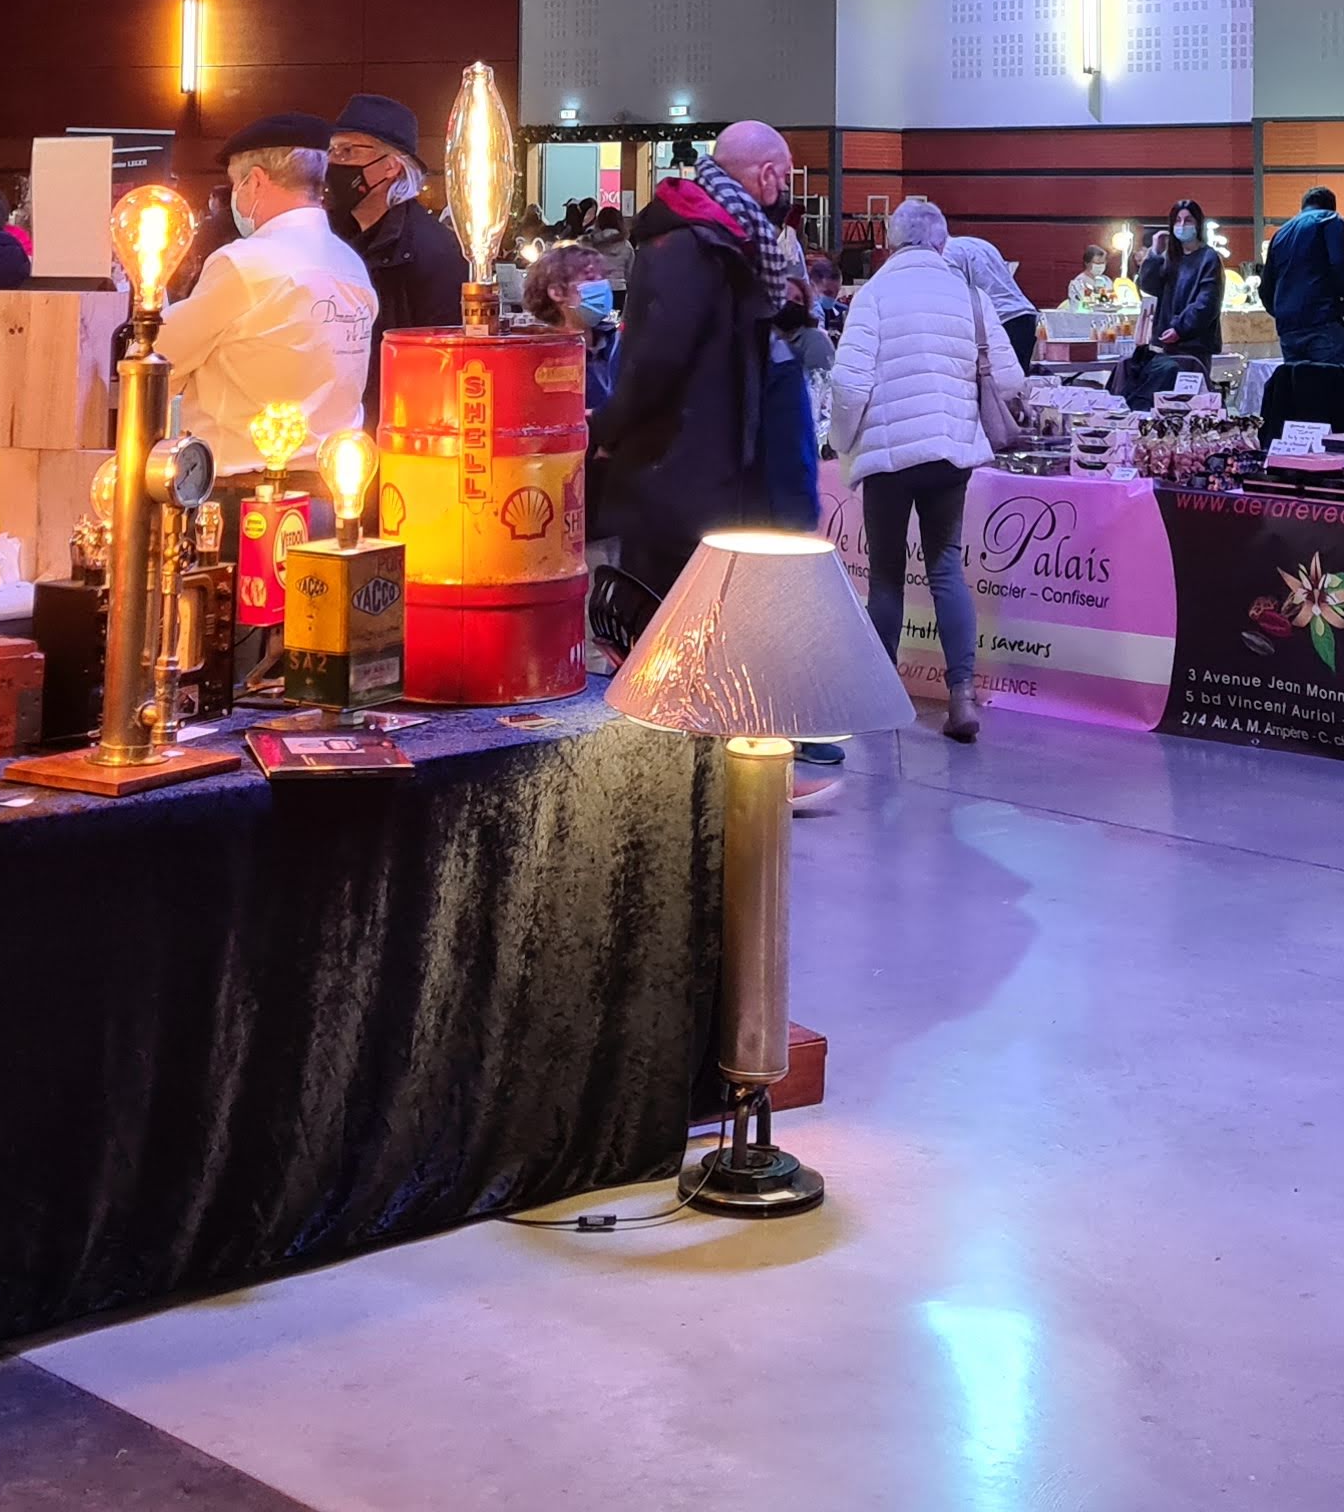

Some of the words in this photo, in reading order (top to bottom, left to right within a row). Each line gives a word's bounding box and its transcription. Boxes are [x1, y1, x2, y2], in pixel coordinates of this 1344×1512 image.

[463, 375, 486, 500] SHELL
[980, 496, 1111, 583] Palais
[356, 579, 396, 612] YACCO
[977, 579, 1026, 599] Glacier
[1041, 586, 1109, 609] Confiseur
[991, 635, 1052, 658] saveurs
[1187, 668, 1197, 681] 3
[1203, 670, 1262, 687] Avenue
[1267, 676, 1301, 694] Jean
[1185, 690, 1195, 702] 5
[1201, 692, 1221, 705] bd
[1227, 695, 1286, 715] Vincent
[1291, 704, 1335, 723] Auriol
